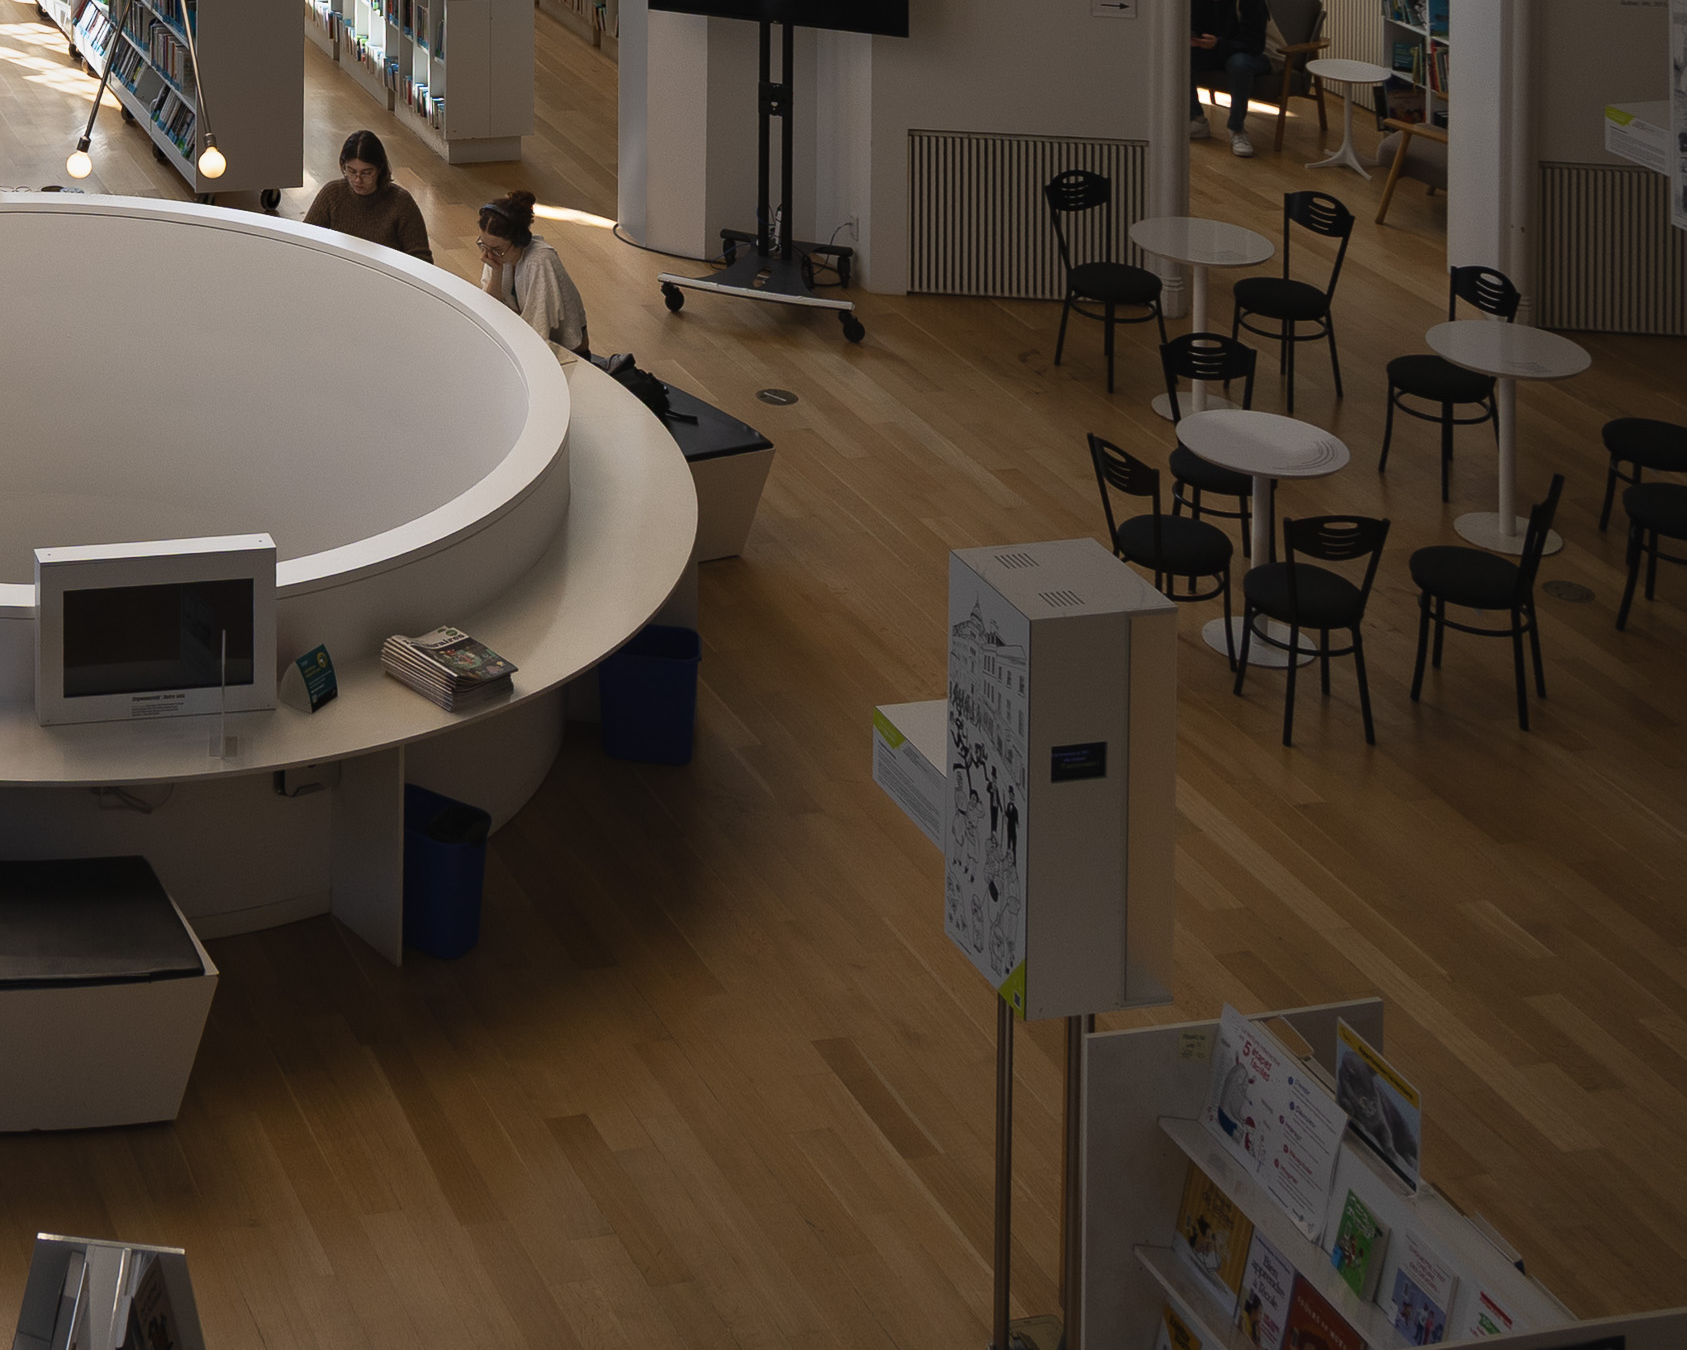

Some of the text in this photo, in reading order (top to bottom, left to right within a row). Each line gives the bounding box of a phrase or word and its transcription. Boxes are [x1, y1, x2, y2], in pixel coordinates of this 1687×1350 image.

[1242, 1041, 1272, 1071] 5 étapes
[1250, 1057, 1271, 1082] faciles
[1264, 1254, 1278, 1279] Bien
